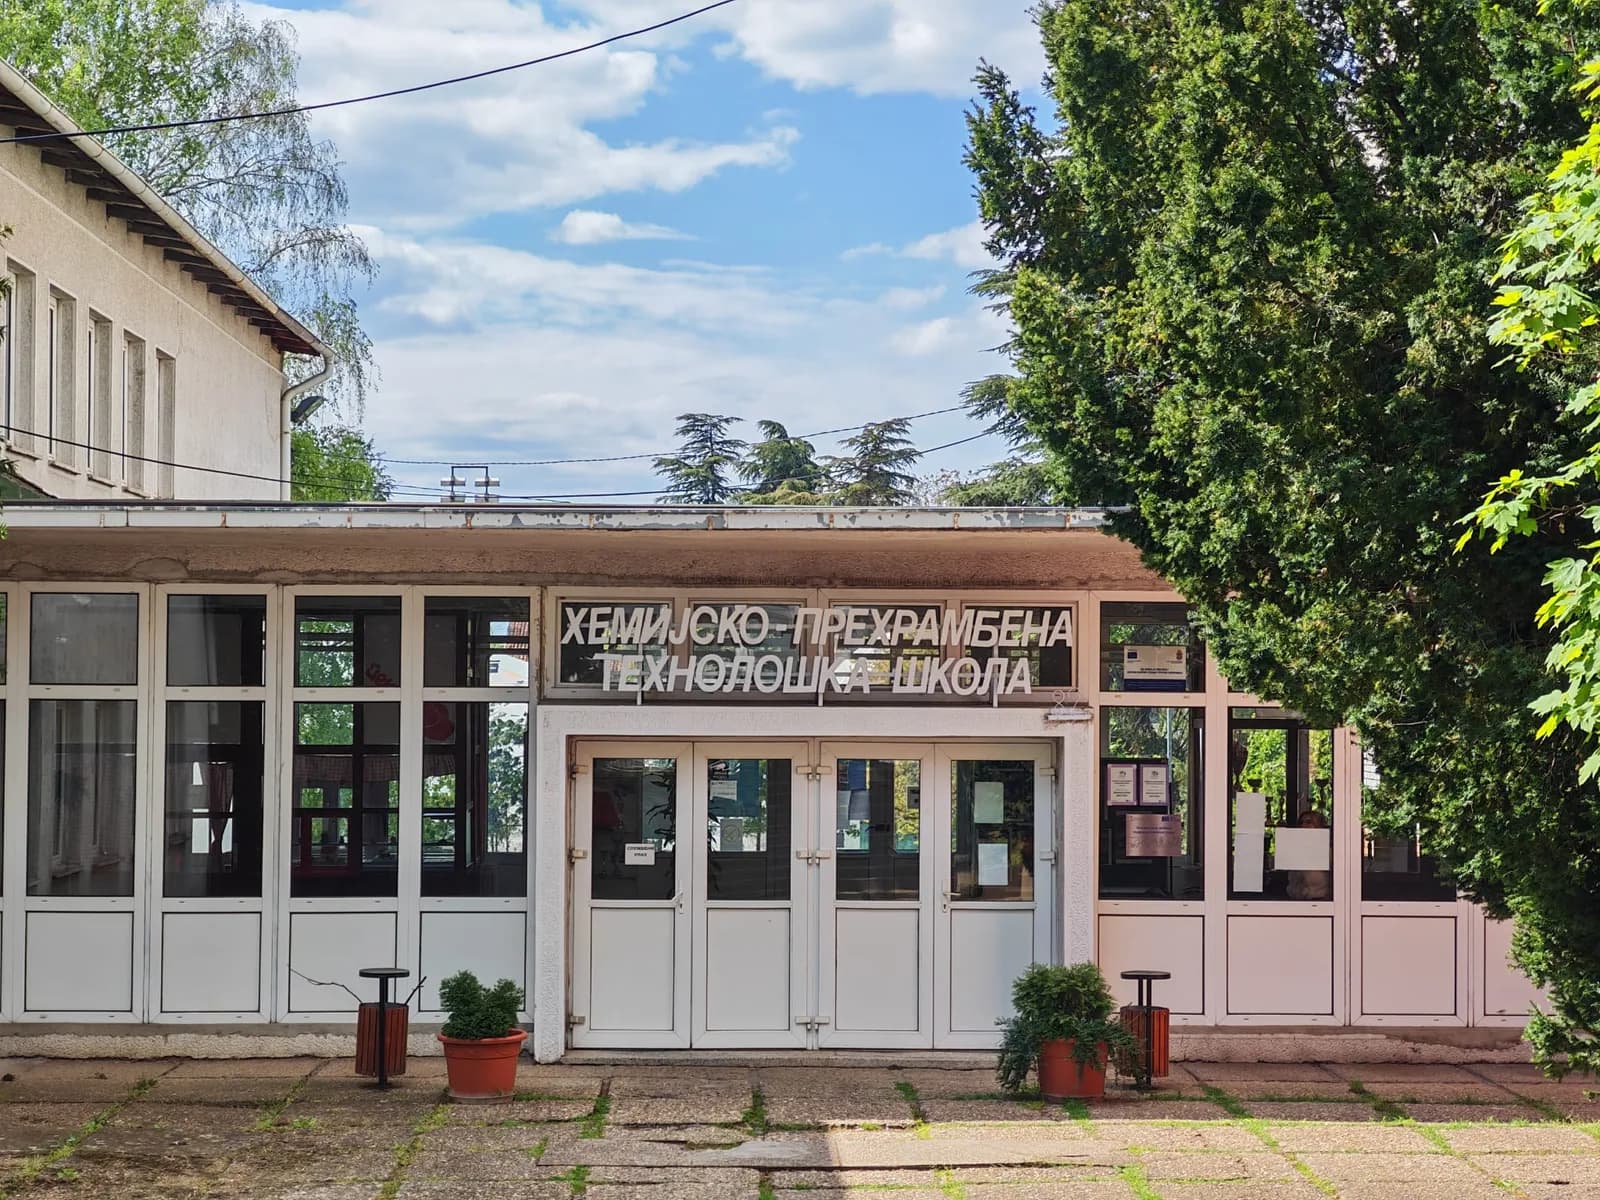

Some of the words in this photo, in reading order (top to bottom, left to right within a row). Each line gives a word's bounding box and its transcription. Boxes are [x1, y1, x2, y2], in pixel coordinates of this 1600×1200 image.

[561, 607, 769, 645] ХЕМИЈСКО
[793, 607, 1072, 647] ПРЕХРАМБЕНА
[592, 653, 870, 693] ТЕХНОЛОШКА
[893, 657, 1032, 695] ШКОЛА
